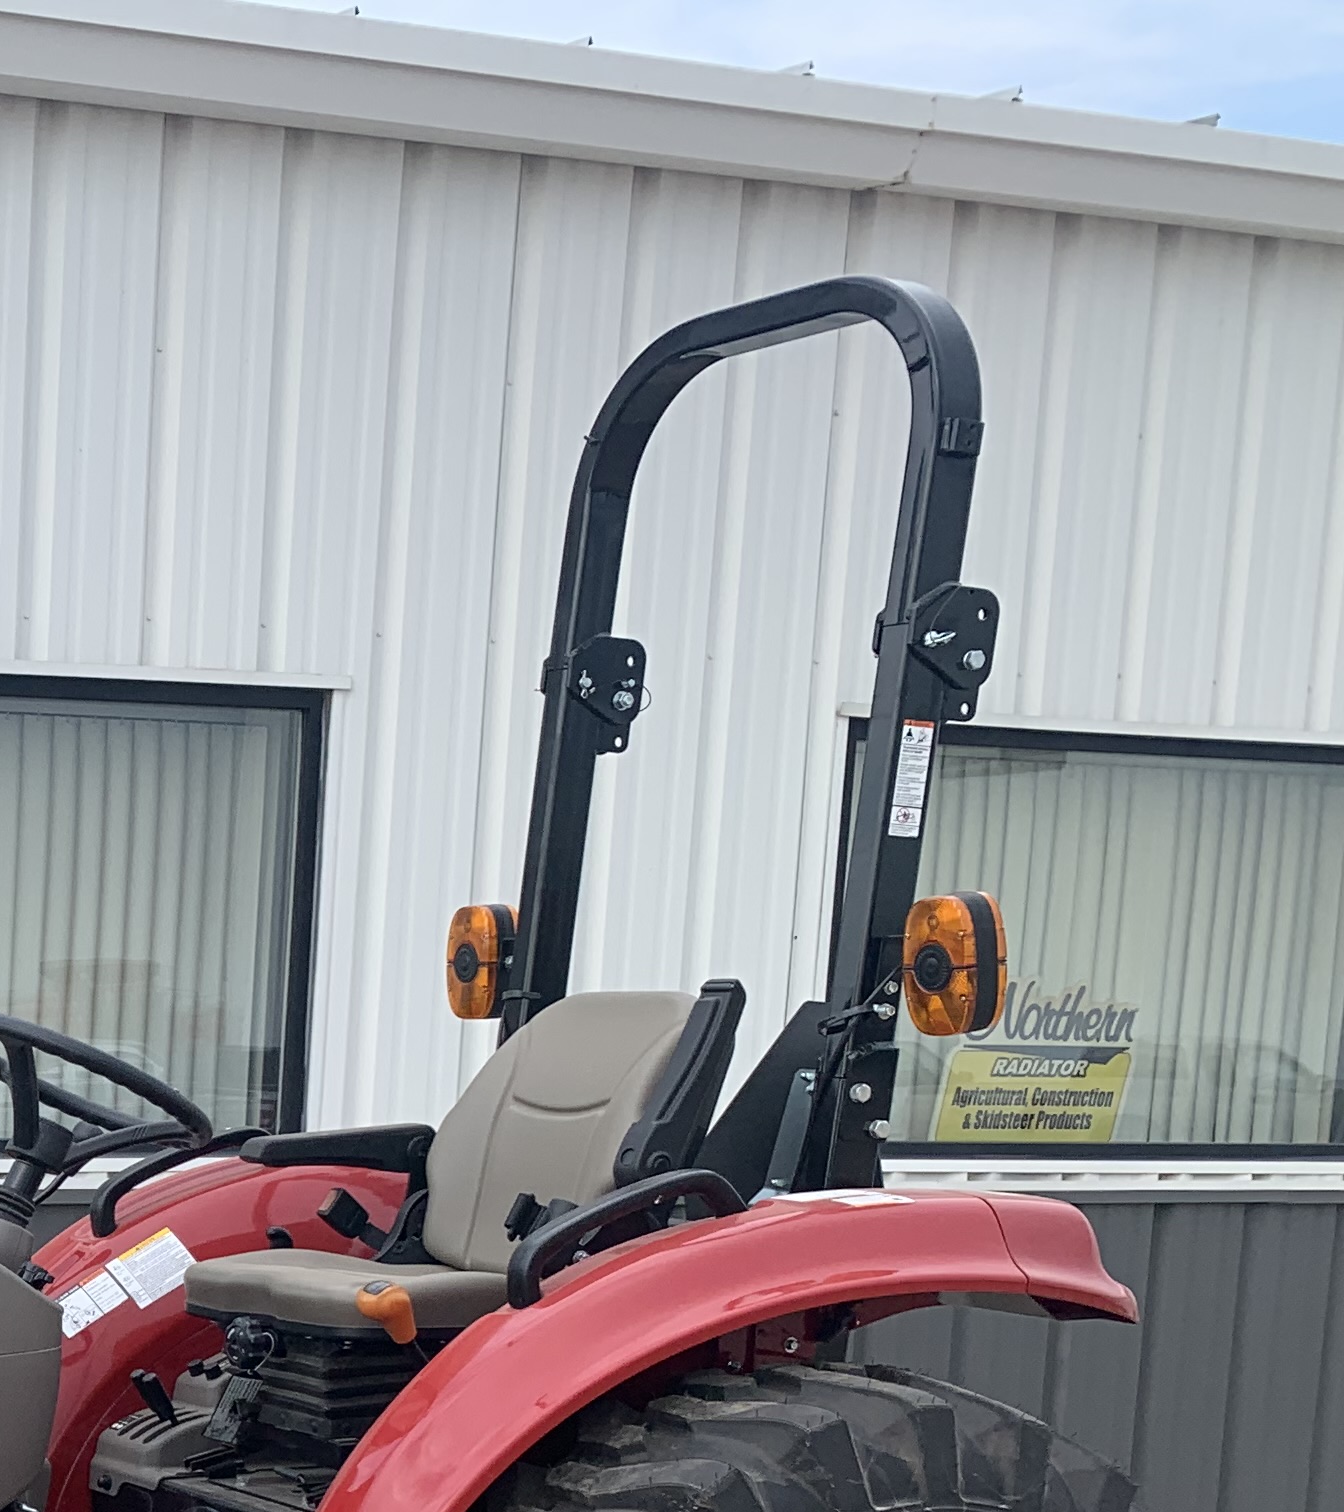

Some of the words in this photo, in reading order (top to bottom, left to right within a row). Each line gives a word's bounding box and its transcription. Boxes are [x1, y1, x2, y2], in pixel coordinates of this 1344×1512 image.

[965, 980, 1140, 1042] Northern
[990, 1057, 1091, 1077] RADIATOR
[952, 1086, 1028, 1107] Agricultural,
[1031, 1086, 1114, 1107] Construction
[962, 1112, 970, 1129] &
[973, 1110, 1034, 1130] Skidsteer
[1035, 1111, 1093, 1130] Products
